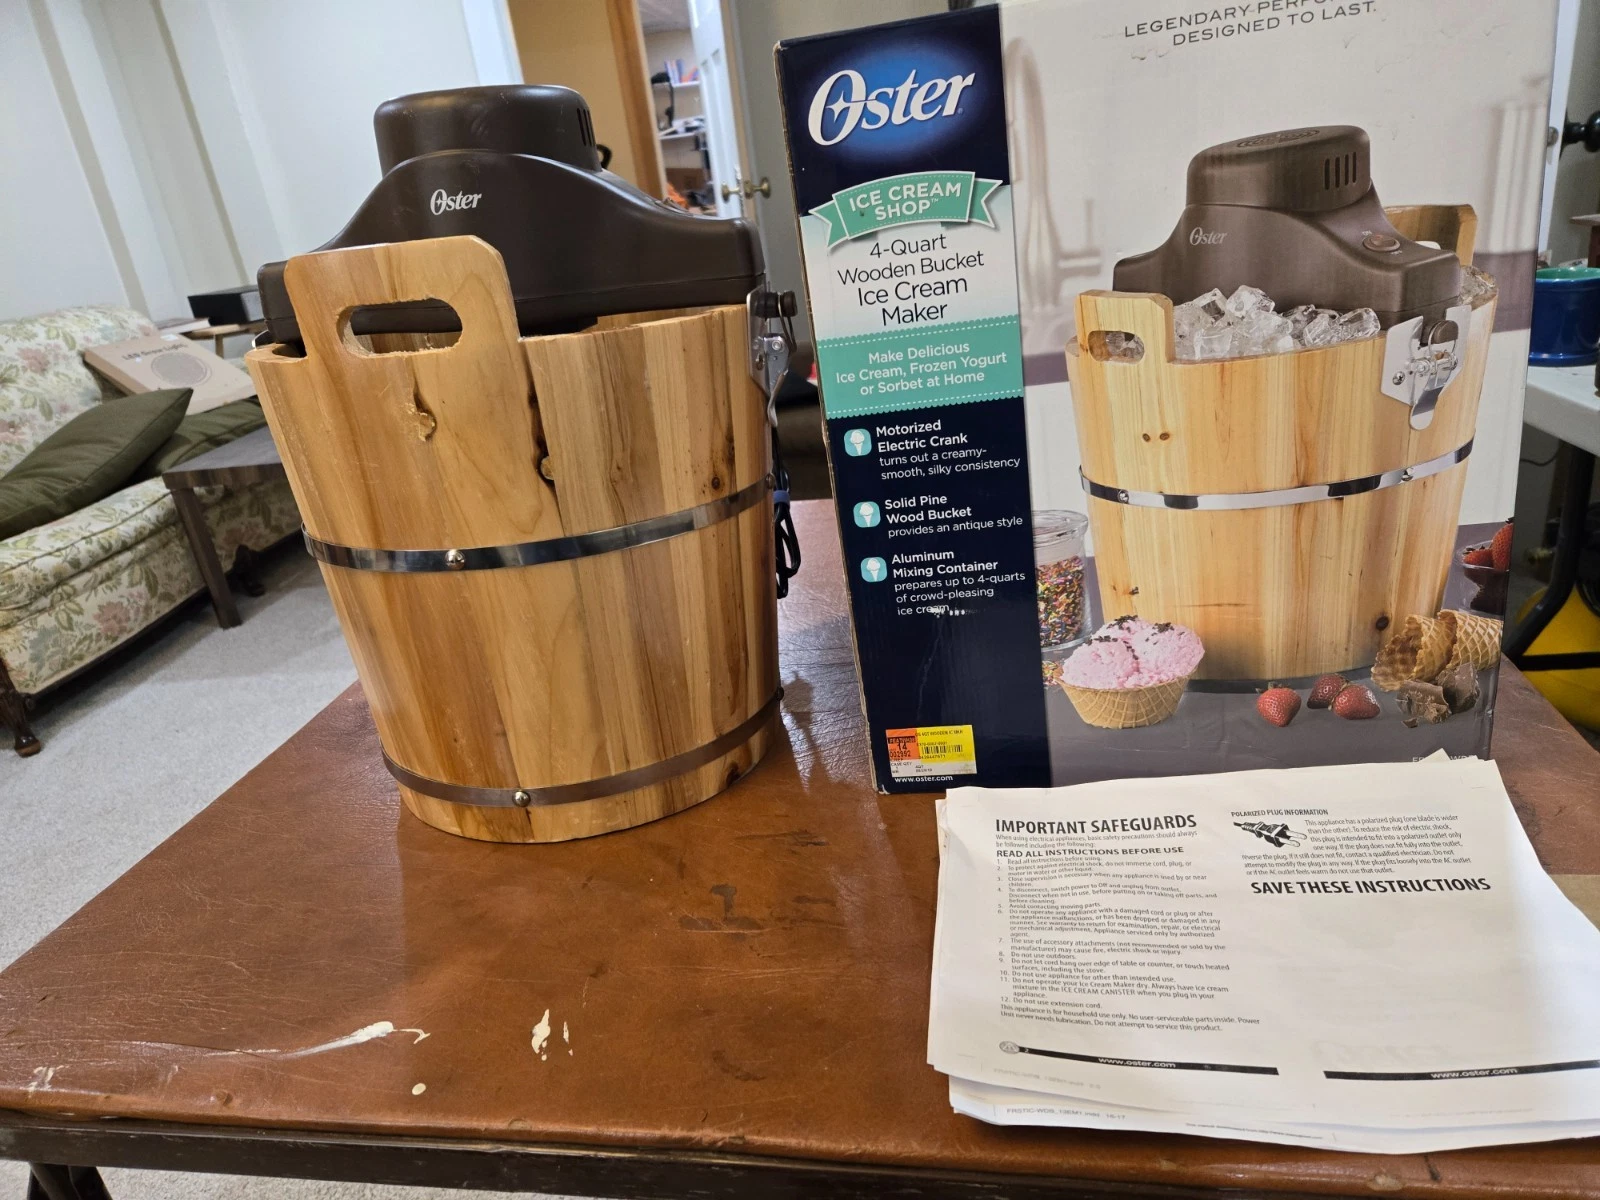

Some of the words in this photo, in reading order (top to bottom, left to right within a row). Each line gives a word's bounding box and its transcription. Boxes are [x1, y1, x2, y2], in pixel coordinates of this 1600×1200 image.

[1124, 5, 1250, 37] LEGENDARY
[1173, 17, 1280, 46] DESIGNED
[1287, 11, 1314, 26] TO
[1322, 1, 1377, 20] LAST.
[807, 69, 976, 146] Oster
[430, 188, 482, 216] Oster
[849, 190, 883, 212] ICE
[888, 182, 962, 201] CREAM
[870, 233, 947, 258] 4-Quart
[1189, 226, 1227, 246] Oster
[837, 260, 915, 286] Wooden
[920, 250, 985, 274] Bucket
[858, 287, 889, 306] Ice
[894, 277, 968, 301] Cream
[882, 302, 948, 326] Maker
[868, 348, 903, 364] Make
[907, 342, 970, 360] Delicious
[836, 371, 856, 384] Ice
[859, 365, 907, 382] Cream,
[910, 359, 957, 375] Frozen
[961, 352, 1007, 371] Yogurt
[860, 384, 874, 396] or
[878, 377, 923, 393] Sorbet
[926, 377, 940, 388] at
[944, 371, 985, 386] Home
[876, 419, 941, 437] Motorized
[877, 438, 926, 453] Electric
[930, 432, 968, 447] Crank
[879, 455, 908, 467] turns
[910, 452, 929, 463] out
[931, 453, 939, 461] a
[941, 447, 987, 460] creamy-
[881, 466, 926, 480] smooth,
[928, 463, 952, 476] silky
[954, 457, 1021, 472] consistency
[885, 496, 917, 510] Solid
[920, 494, 948, 506] Pine
[886, 510, 924, 524] Wood
[928, 506, 972, 520] Bucket
[888, 523, 934, 539] provides
[937, 523, 950, 533] an
[953, 519, 994, 532] antique
[996, 515, 1023, 528] style
[892, 550, 955, 564] Aluminum
[893, 564, 934, 579] Mixing
[936, 560, 999, 574] Container
[894, 579, 942, 592] prepares
[945, 577, 959, 588] up
[962, 575, 974, 585] to
[977, 571, 1026, 586] 4-quarts
[896, 593, 907, 603] of
[910, 587, 994, 602] crowd-pleasing
[897, 606, 913, 616] ice
[894, 775, 954, 783] www.oster.com
[1284, 808, 1329, 816] INFORMATION
[996, 819, 1087, 834] IMPORTANT
[1091, 814, 1197, 833] SAFEGUARDS
[996, 850, 1023, 858] READ
[1025, 850, 1044, 858] ALL
[1045, 848, 1120, 857] INSTRUCTIONS
[1121, 847, 1162, 855] BEFORE
[1251, 881, 1295, 894] SAVE
[1296, 881, 1353, 894] THESE
[1355, 878, 1491, 894] INSTRUCTIONS
[1048, 972, 1080, 980] appliance
[1074, 987, 1099, 995] CREAM
[1100, 988, 1135, 996] CANISTER
[1173, 991, 1189, 999] plug
[1098, 1057, 1177, 1069] www.oster.com
[1430, 1066, 1518, 1079] www.oster.com
